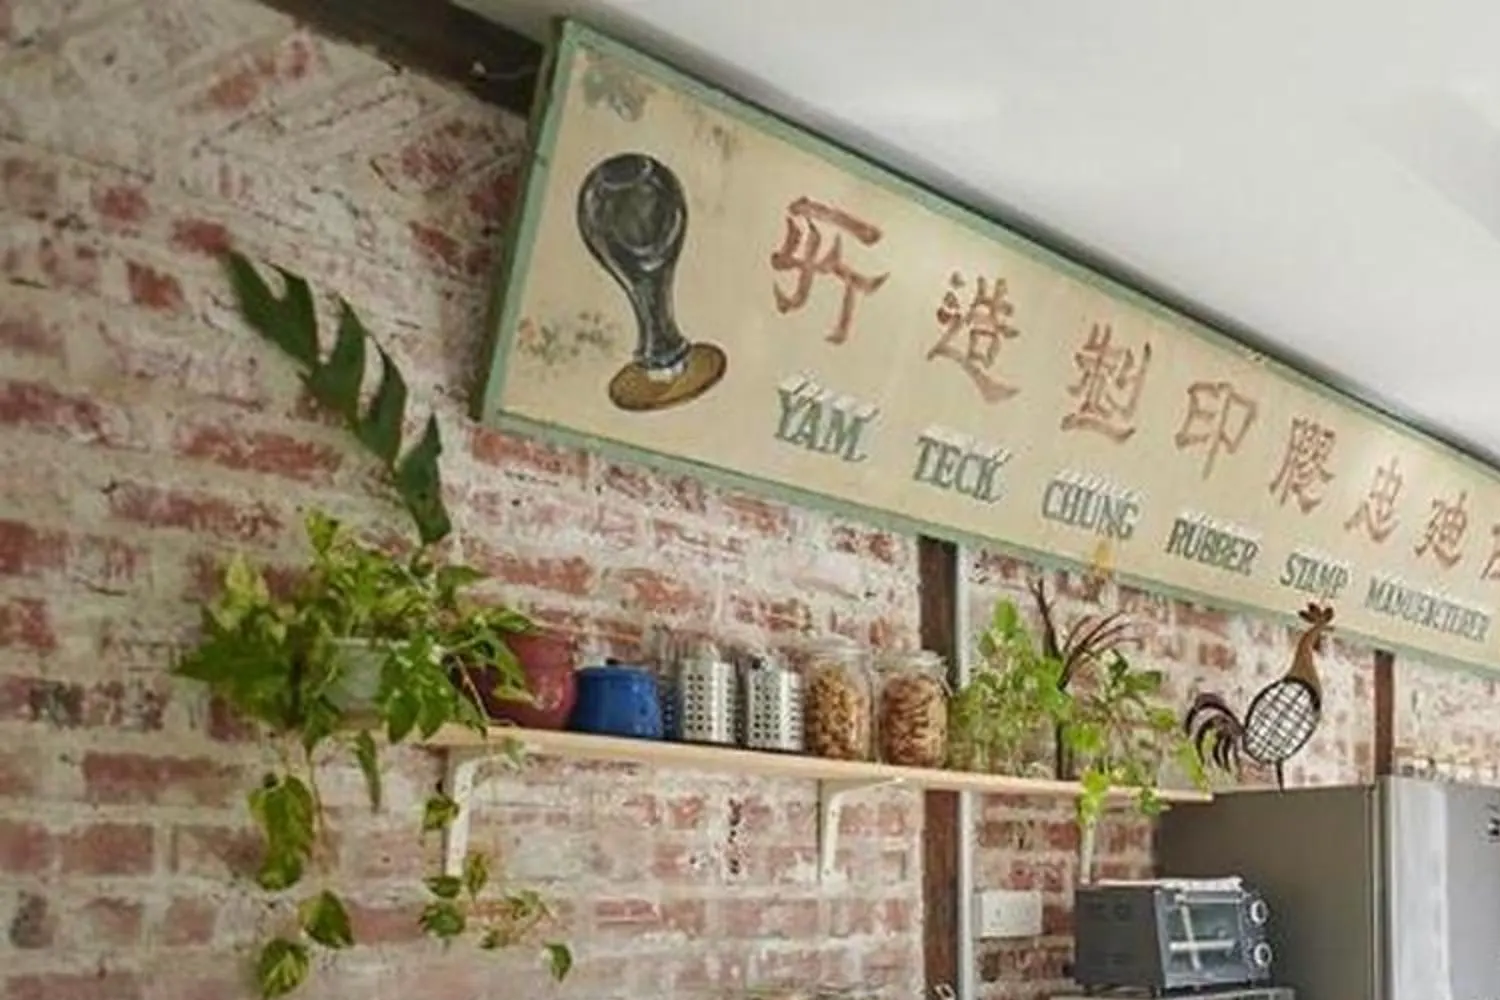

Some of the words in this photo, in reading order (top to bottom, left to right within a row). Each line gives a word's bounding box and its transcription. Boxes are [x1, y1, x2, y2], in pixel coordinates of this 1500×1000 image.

[773, 378, 876, 464] YAM
[912, 430, 1013, 504] TECK
[1041, 474, 1139, 542] CHUNG
[1166, 514, 1261, 577] RUBBER
[1279, 550, 1351, 599] STAMP
